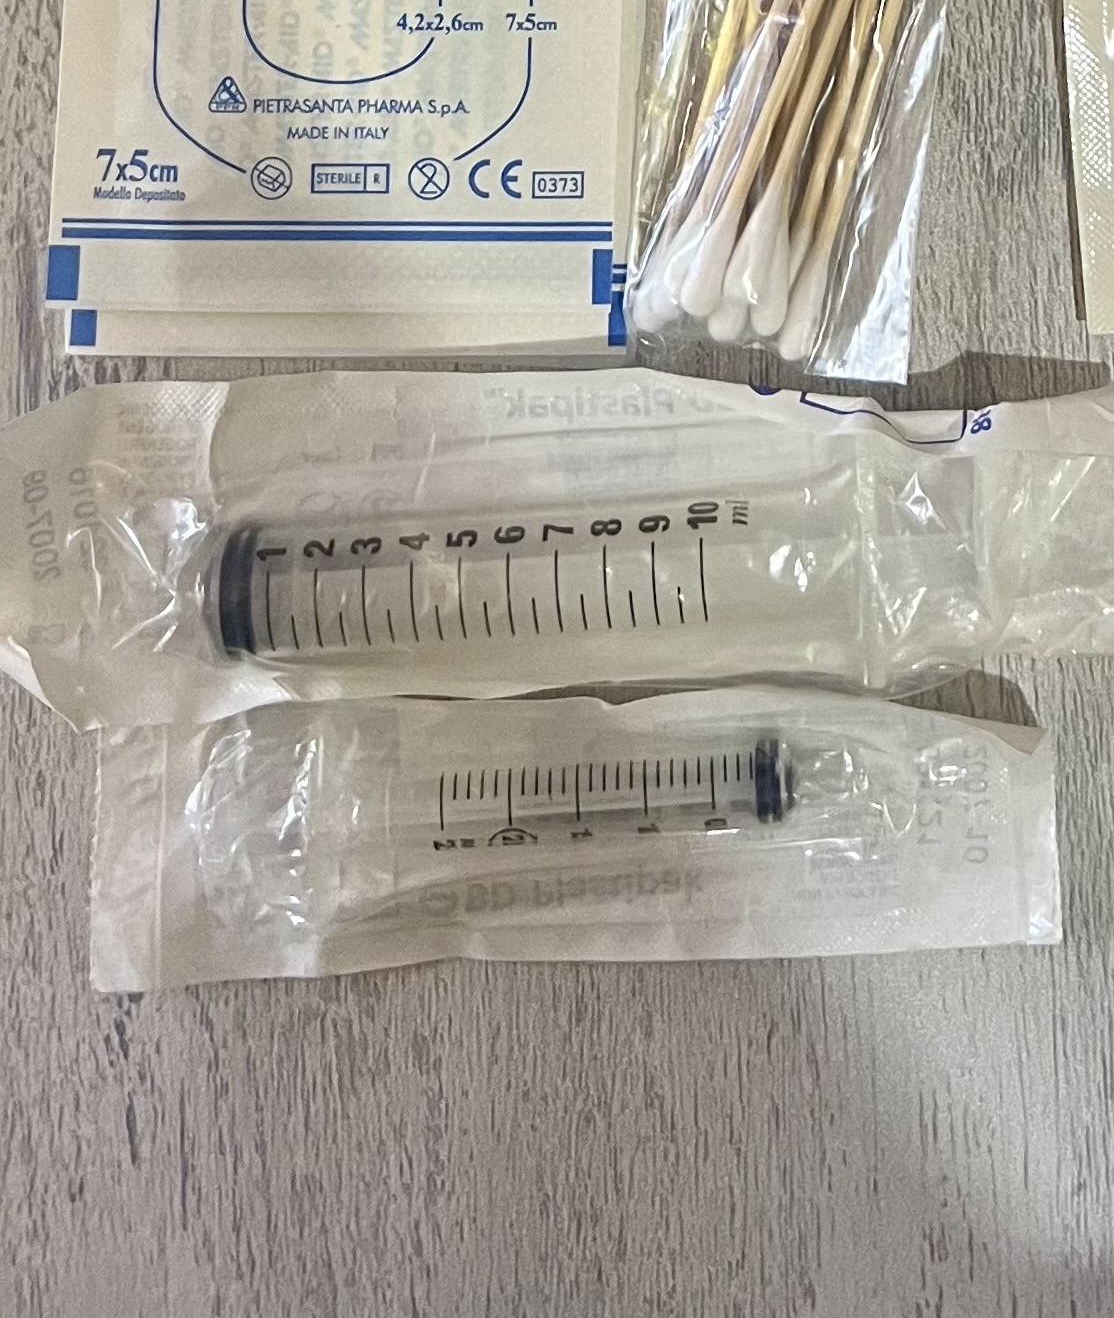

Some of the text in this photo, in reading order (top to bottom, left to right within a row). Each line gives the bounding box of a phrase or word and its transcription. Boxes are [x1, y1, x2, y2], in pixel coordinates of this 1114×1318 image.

[505, 13, 558, 32] 7x5cm
[253, 99, 354, 114] PIETRASANTA
[359, 99, 423, 114] PHARMA
[287, 127, 389, 140] MADE IN ITALY
[95, 148, 179, 183] 7x5cm
[316, 172, 380, 184] STERILE R
[537, 177, 578, 193] 0373
[257, 547, 286, 562] 1
[304, 539, 334, 558] 2
[351, 536, 381, 555] 3
[399, 532, 430, 551] 4
[446, 529, 478, 548] 5
[494, 526, 526, 544] 6
[542, 524, 574, 542] 7
[591, 518, 622, 536] 8
[639, 515, 670, 533] 9
[687, 501, 720, 530] 10
